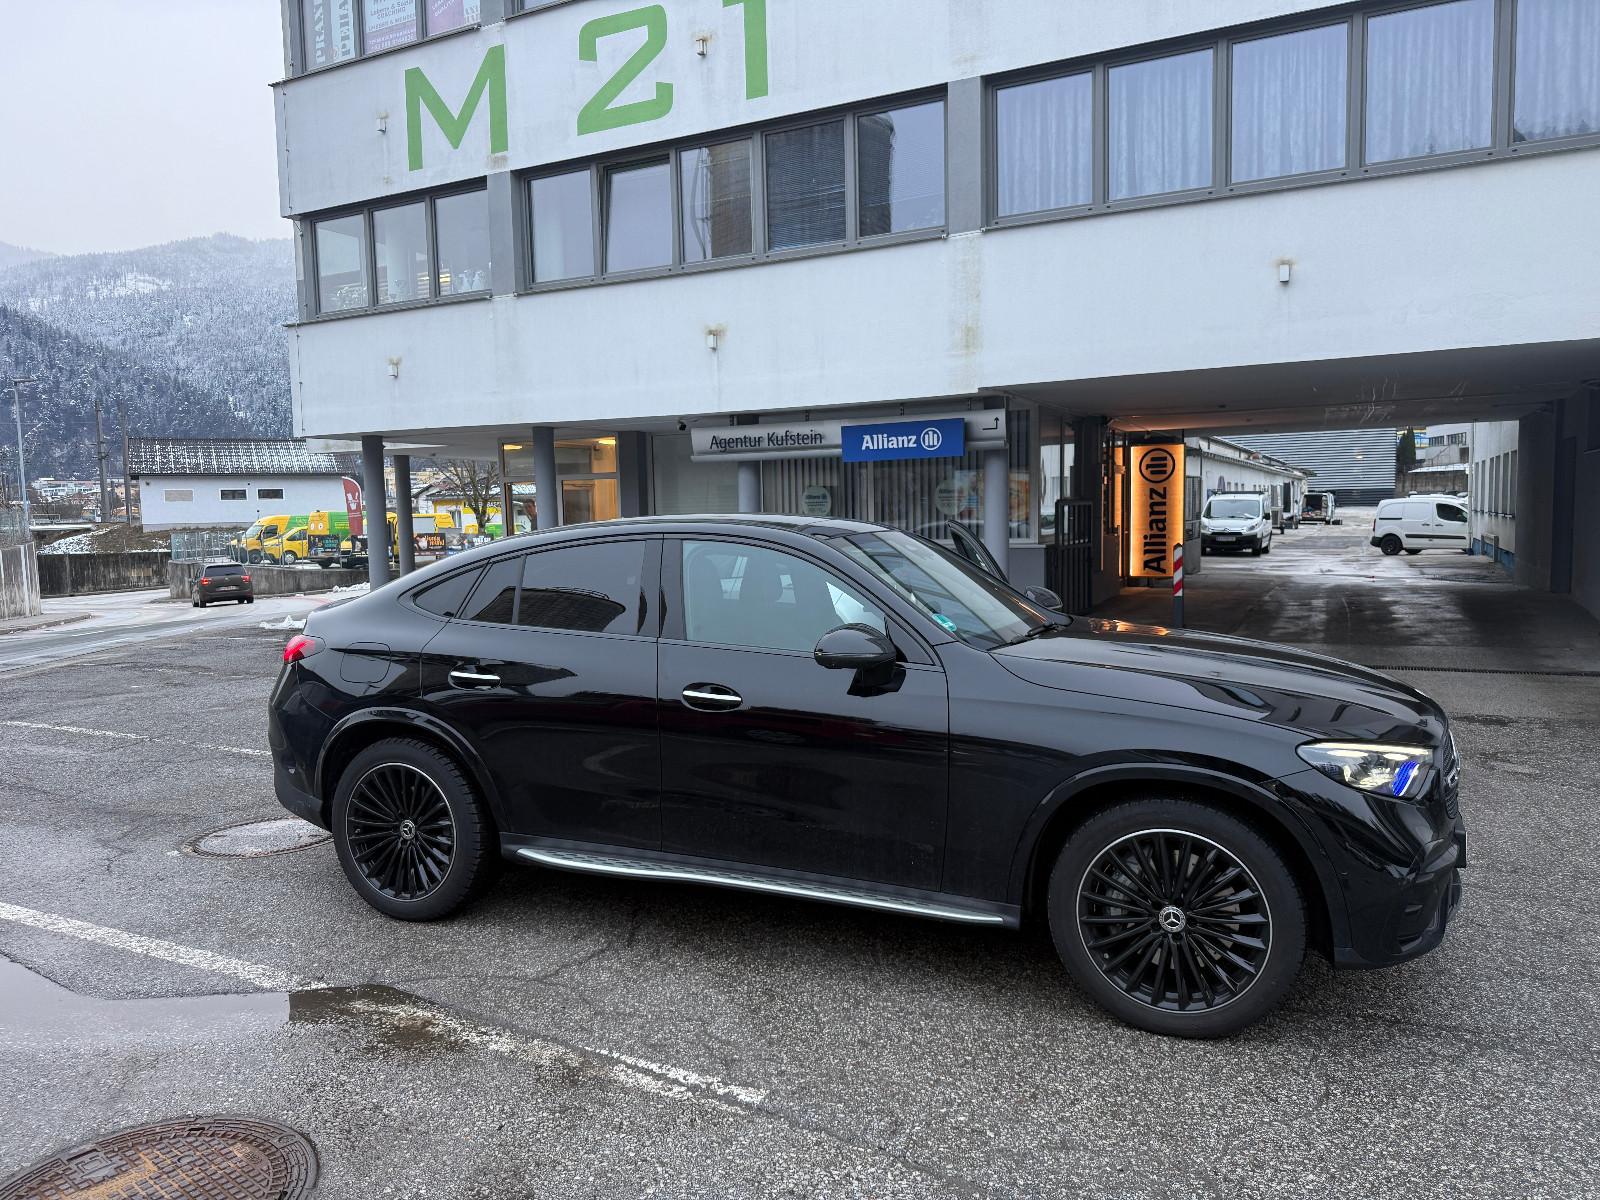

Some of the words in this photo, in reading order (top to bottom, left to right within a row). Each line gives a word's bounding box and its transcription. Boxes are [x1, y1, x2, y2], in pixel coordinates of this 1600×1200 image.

[405, 44, 509, 172] M
[709, 433, 763, 453] Agentur
[767, 429, 823, 447] Kufstein
[861, 433, 917, 451] Allianz
[1143, 487, 1167, 574] Allianz
